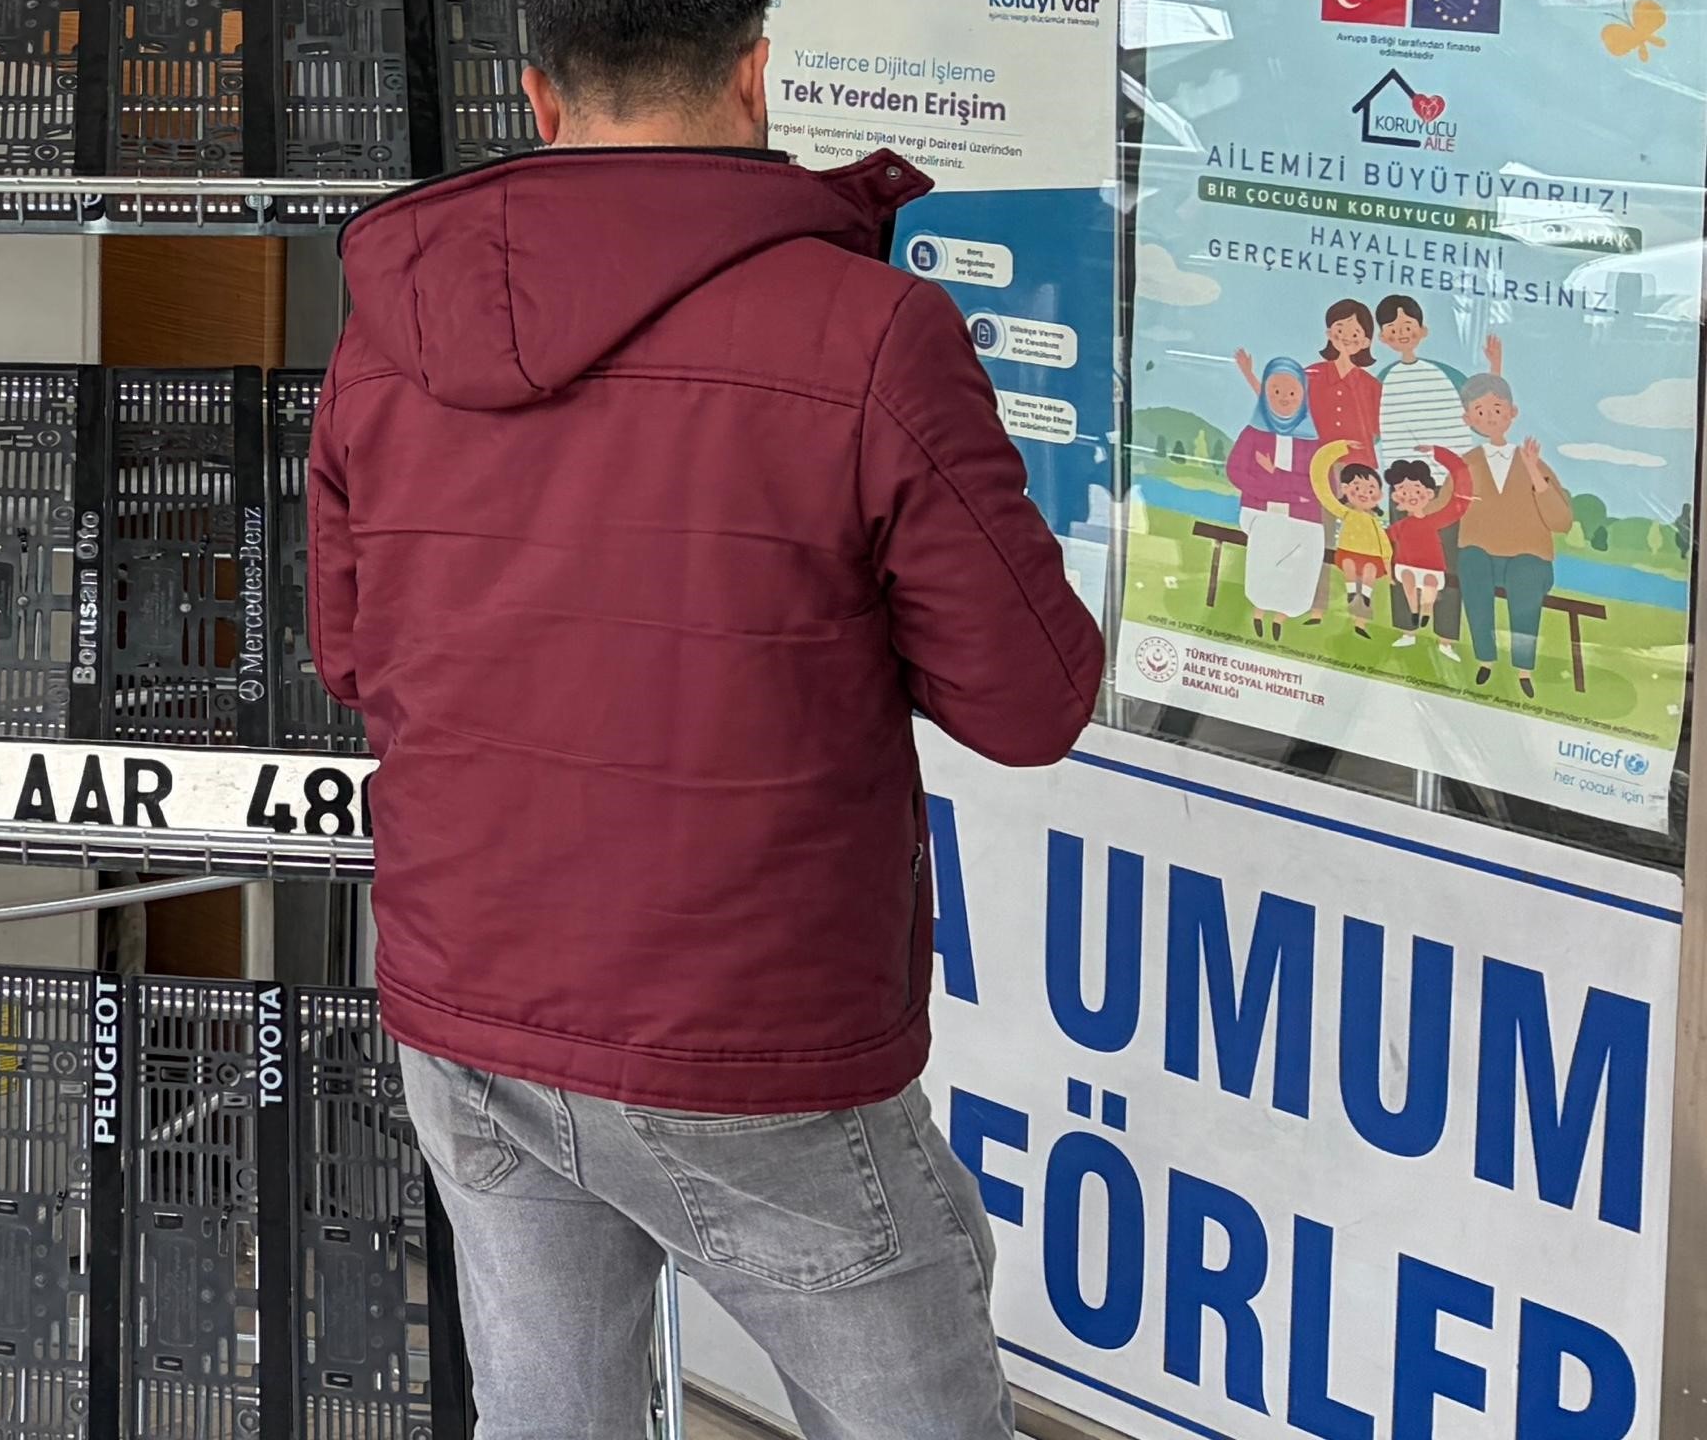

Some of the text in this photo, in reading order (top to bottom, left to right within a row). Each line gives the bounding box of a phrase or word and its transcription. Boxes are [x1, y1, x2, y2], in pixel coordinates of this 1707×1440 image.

[795, 49, 995, 84] Yüzlerce Dijital İşleme
[781, 79, 1006, 126] Tek Yerden Erişim
[898, 135, 926, 150] Vergi
[1375, 115, 1457, 138] KORUYUCU
[1206, 141, 1345, 182] AİLEMİZİ
[1207, 182, 1237, 199] BİR
[1245, 187, 1338, 213] ÇOCUĞUN
[1347, 200, 1456, 227] KORUYUCU
[1310, 225, 1503, 270] HAYALLERİNİ
[72, 510, 100, 685] Borusan Oto
[238, 506, 264, 676] Mercedes-Benz
[1181, 676, 1239, 700] BAKANLIĞI
[1182, 662, 1325, 706] AİLE VE SOSYAL HİZMETLER
[1185, 647, 1303, 686] TÜRKİYE CUMHURİYETİ
[1557, 738, 1624, 770] unicef
[13, 753, 173, 828] AAR
[247, 762, 371, 837] 48
[1553, 768, 1644, 806] her çocuk için
[258, 986, 283, 1108] TOYOTA
[1045, 828, 1651, 1236] UMUM
[94, 975, 119, 1144] PEUGEOT
